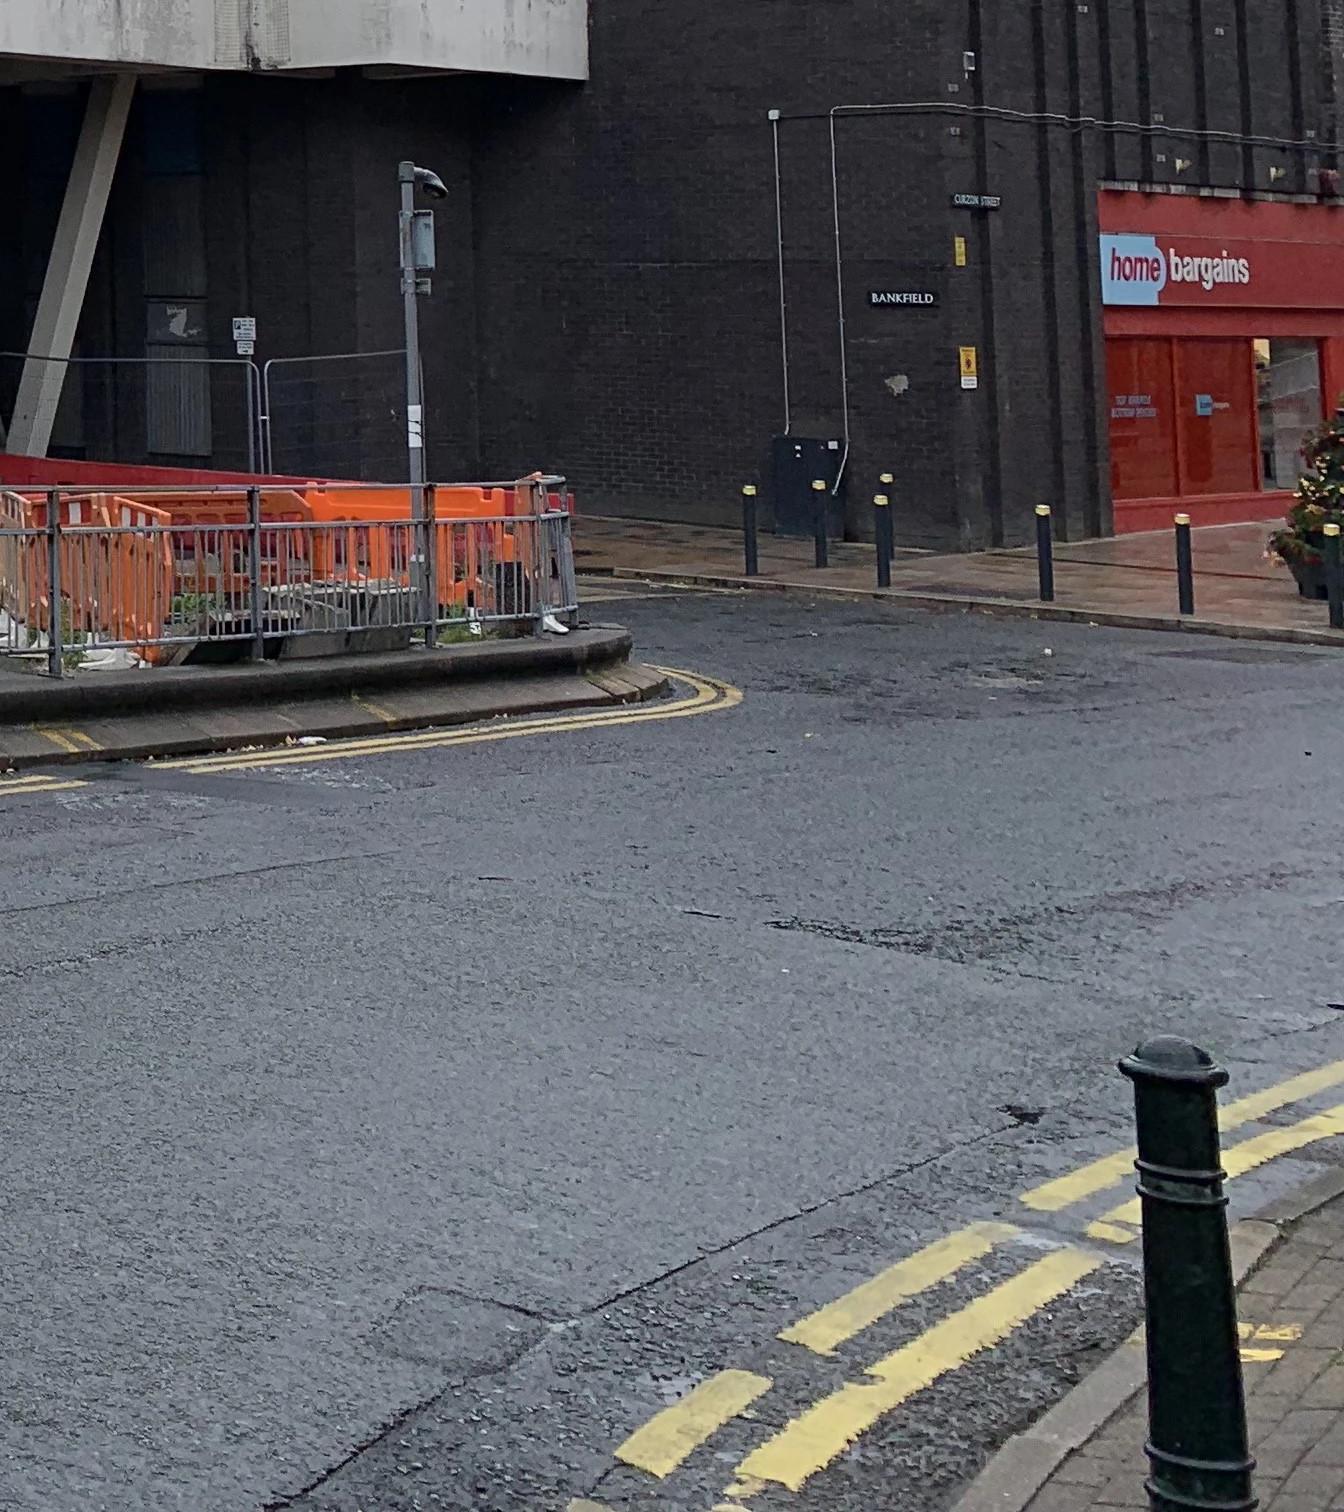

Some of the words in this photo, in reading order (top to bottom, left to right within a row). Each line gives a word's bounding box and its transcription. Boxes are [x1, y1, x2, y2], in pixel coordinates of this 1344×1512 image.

[980, 195, 1001, 206] STREET
[1111, 247, 1161, 282] home
[1169, 247, 1250, 290] bargains
[871, 292, 934, 304] BANKFIELD
